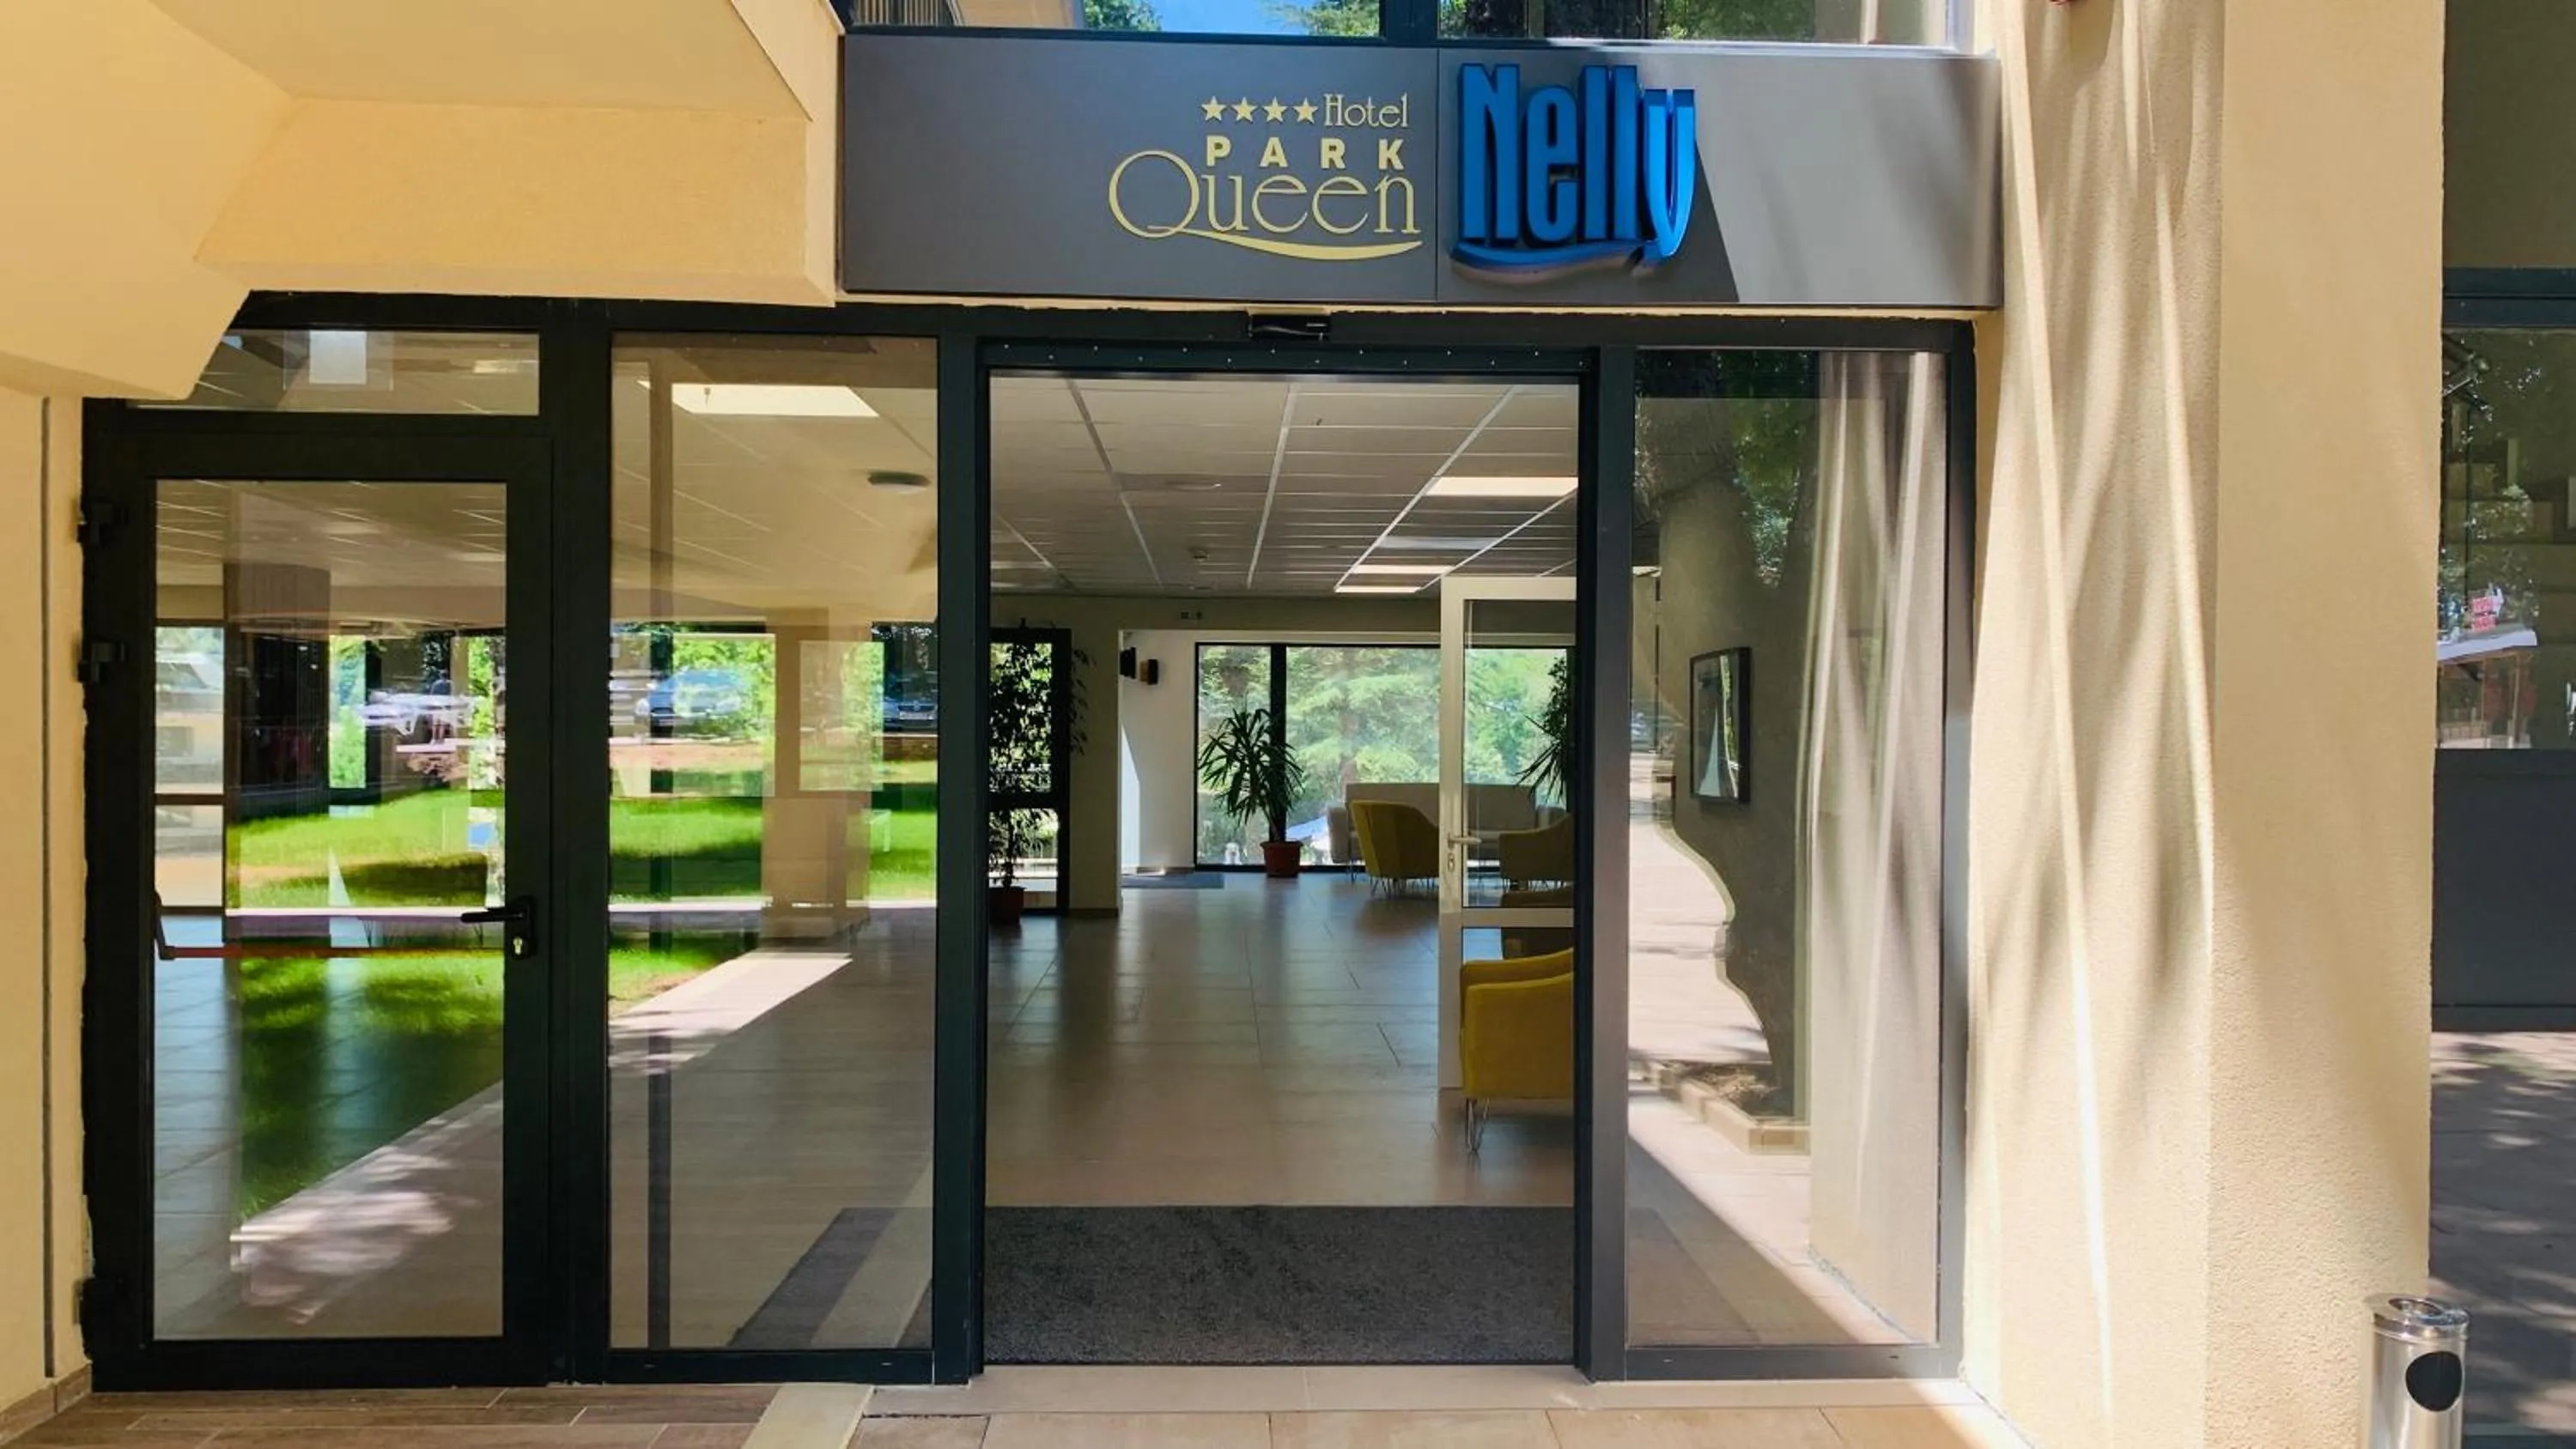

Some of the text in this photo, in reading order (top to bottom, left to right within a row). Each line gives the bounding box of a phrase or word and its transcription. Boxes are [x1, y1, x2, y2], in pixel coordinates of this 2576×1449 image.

[1323, 92, 1410, 128] Hotel
[1206, 135, 1405, 170] PARK
[1453, 63, 1697, 266] Nelly
[1109, 150, 1423, 259] Queen
